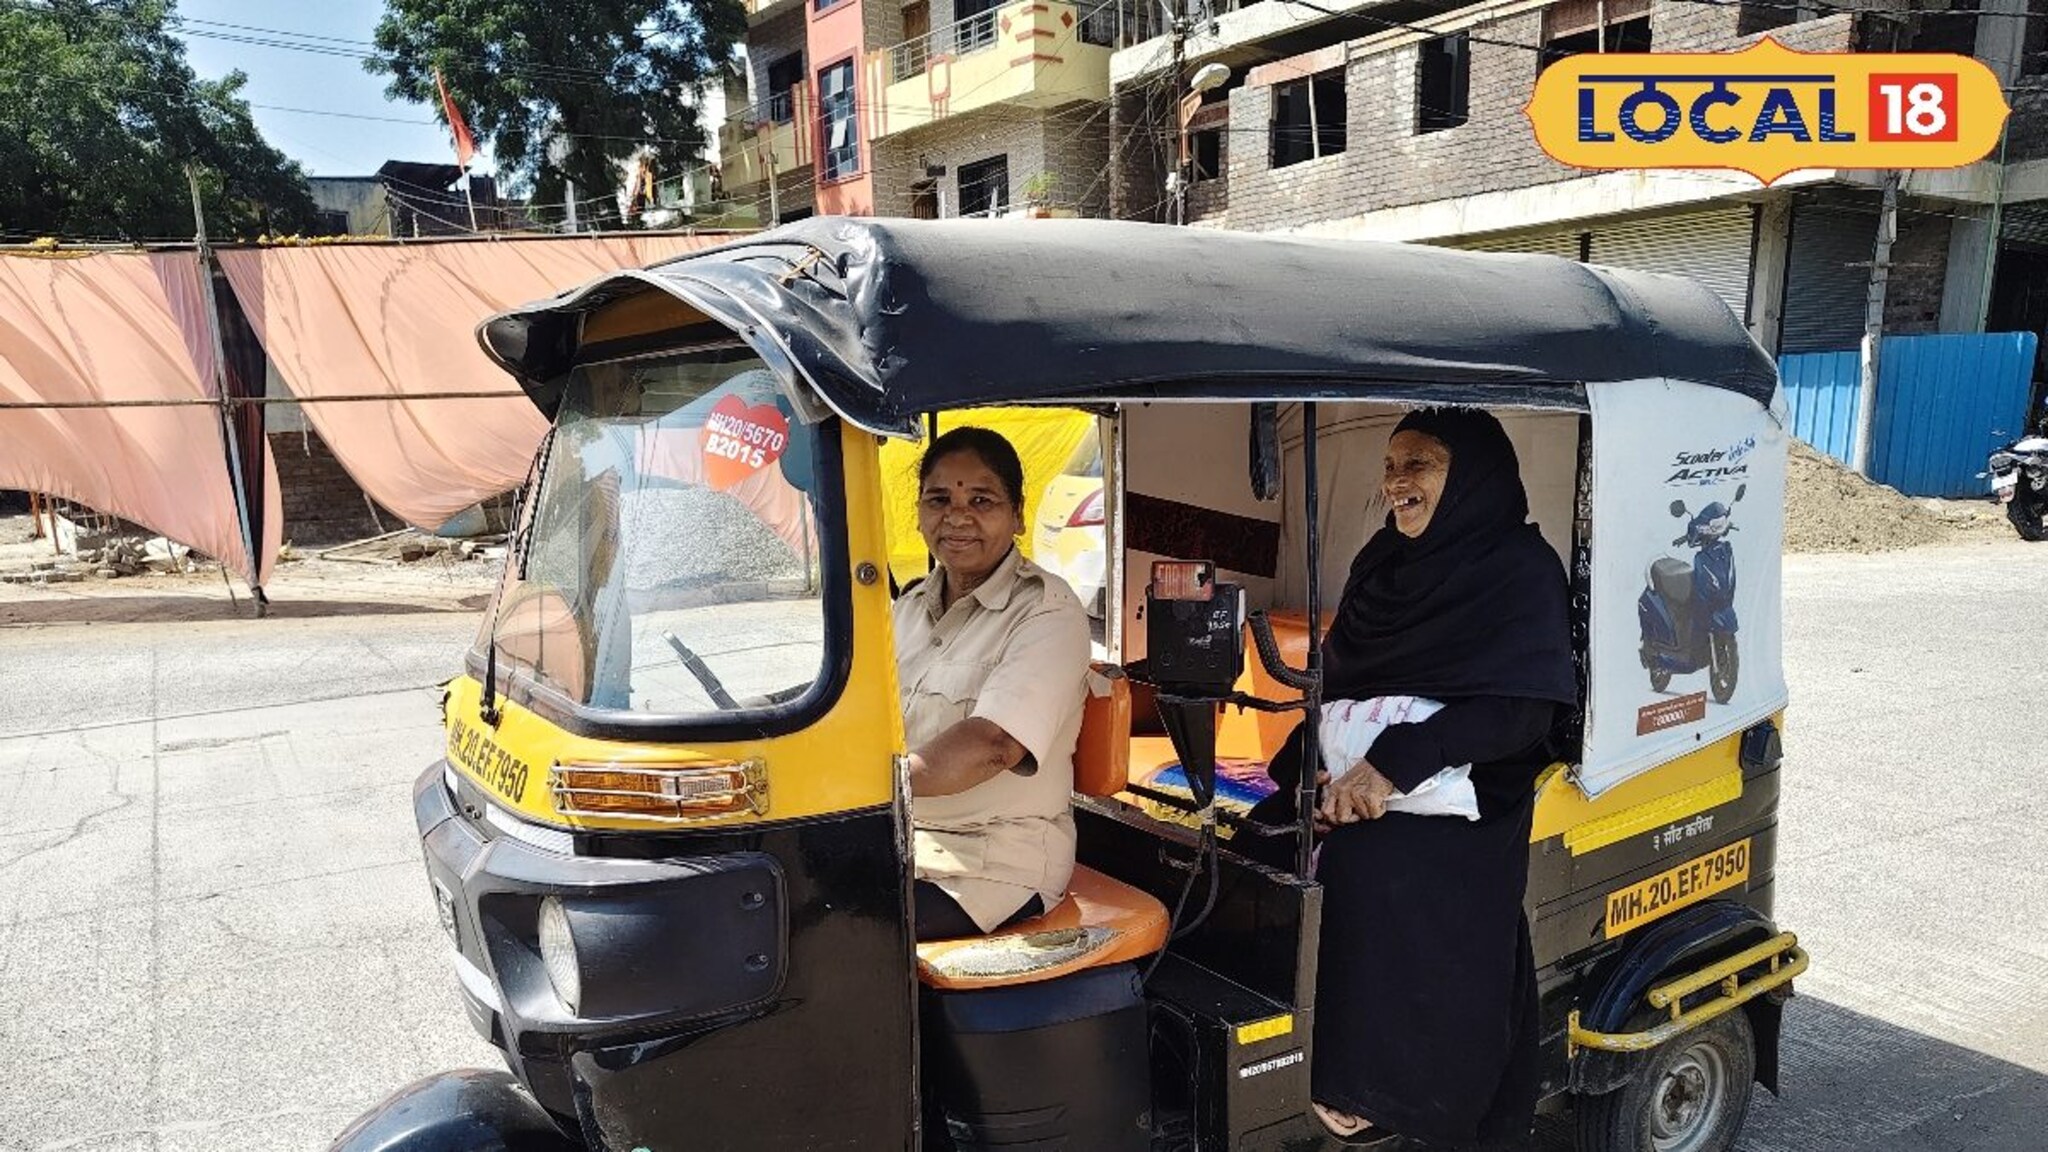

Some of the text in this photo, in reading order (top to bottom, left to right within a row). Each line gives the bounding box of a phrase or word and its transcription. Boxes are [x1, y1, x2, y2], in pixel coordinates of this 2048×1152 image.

[705, 433, 765, 469] B2015
[706, 412, 784, 451] MH20/5670
[1610, 844, 1746, 928] MH.20.EF.7950
